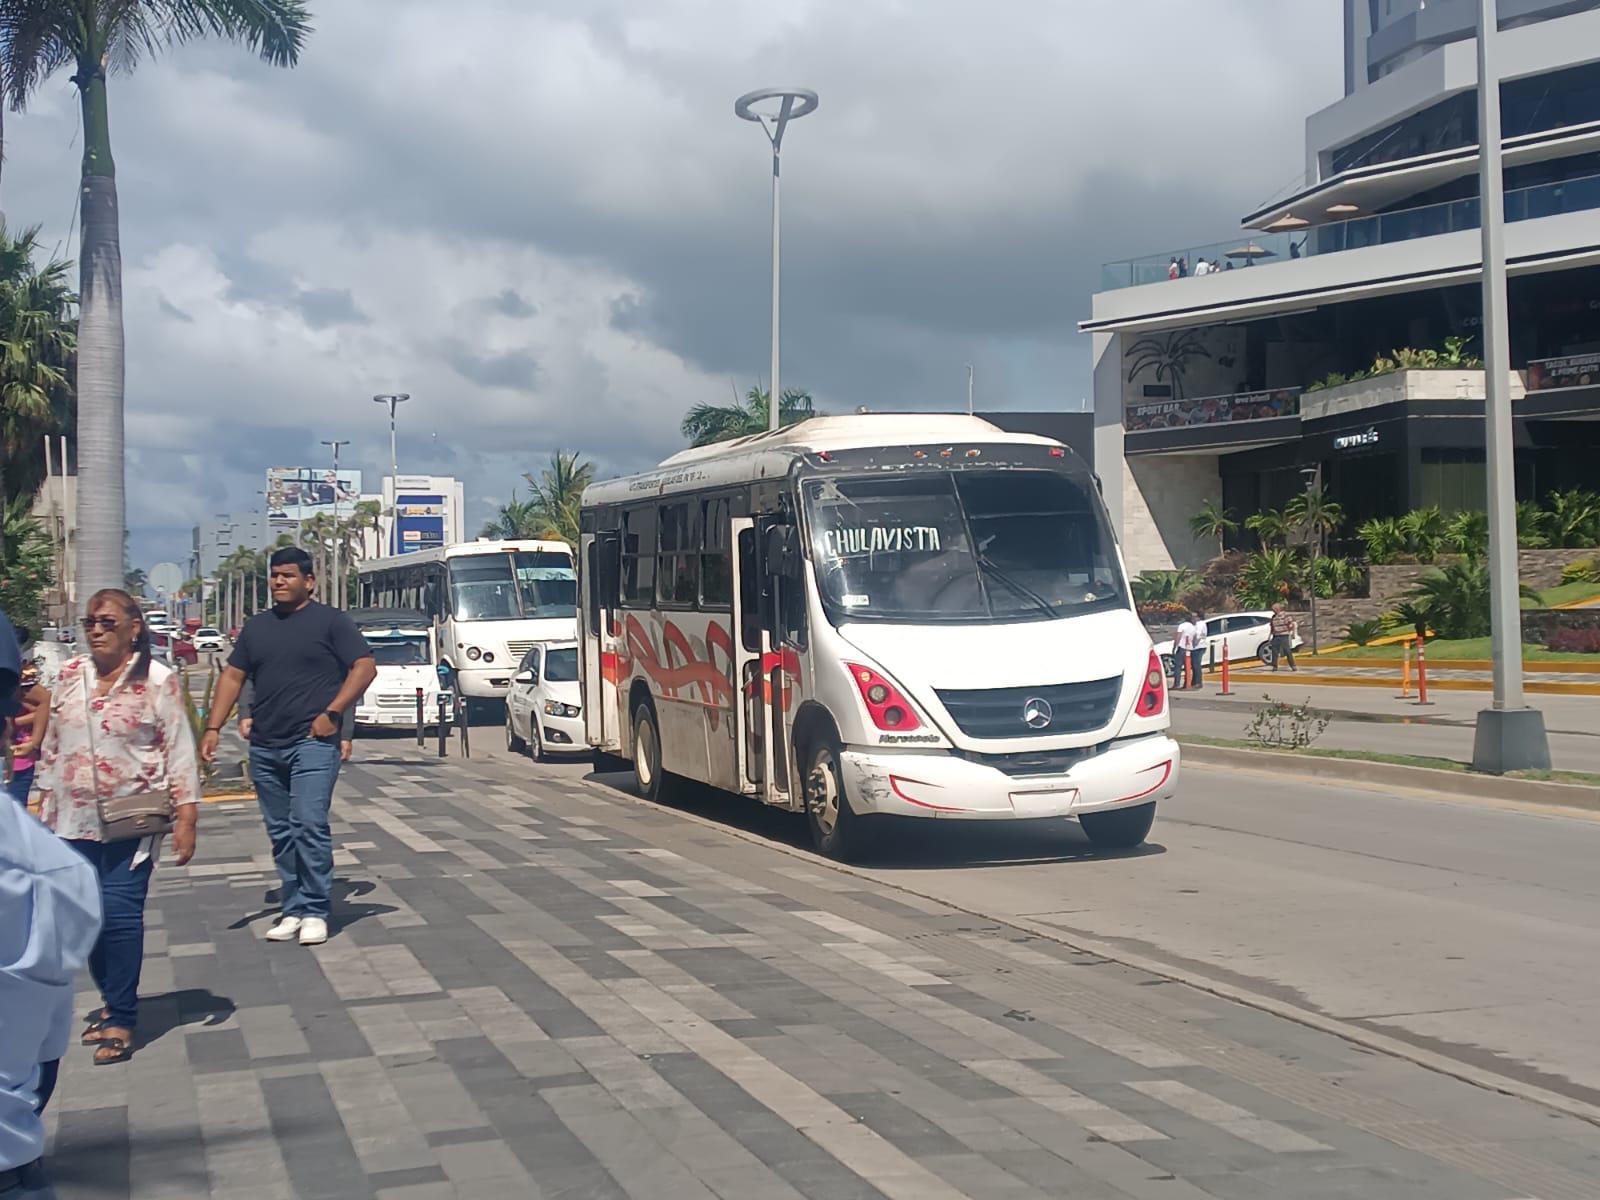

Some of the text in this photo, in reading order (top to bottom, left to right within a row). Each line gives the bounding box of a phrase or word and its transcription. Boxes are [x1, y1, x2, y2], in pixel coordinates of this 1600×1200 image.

[1136, 403, 1181, 416] SPORT BAR
[824, 526, 940, 556] CHULAVISTA
